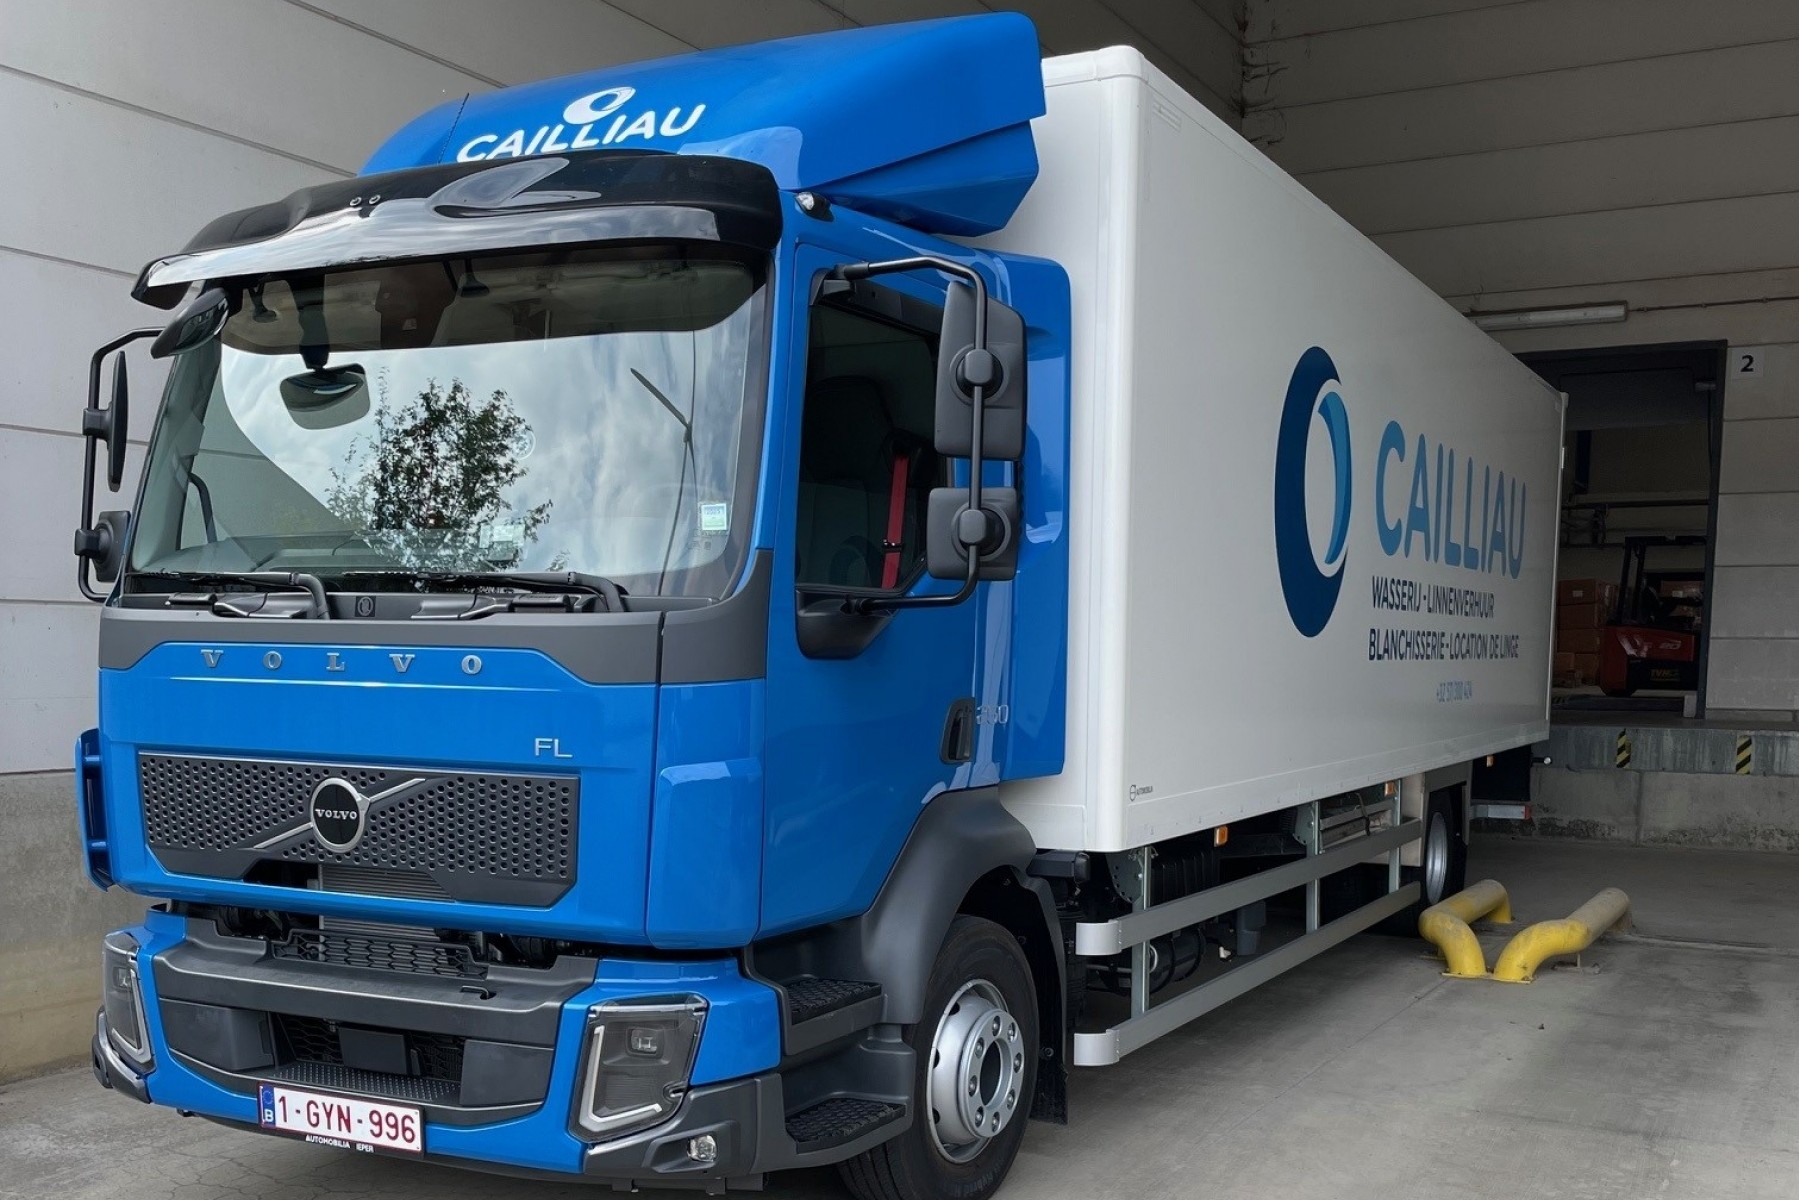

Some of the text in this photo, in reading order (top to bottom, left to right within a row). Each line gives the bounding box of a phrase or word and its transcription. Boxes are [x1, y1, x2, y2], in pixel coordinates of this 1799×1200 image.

[456, 104, 706, 163] CAILLIAU
[1740, 354, 1754, 373] 2
[1376, 420, 1526, 579] CAILLIAU
[1372, 575, 1422, 612] WASSERIJ
[1427, 584, 1495, 618] LINNENVERHUUR
[1369, 628, 1446, 661] BLANCHISSERIE
[1450, 633, 1488, 660] LOCATION
[1489, 634, 1499, 659] DE
[200, 649, 483, 675] VOLVO
[534, 737, 574, 759] FL
[314, 808, 358, 820] VOLVO
[264, 1108, 275, 1123] B
[279, 1096, 415, 1143] 1-GYN-996
[305, 1133, 375, 1153] AUTOMOBILIA IEPER
